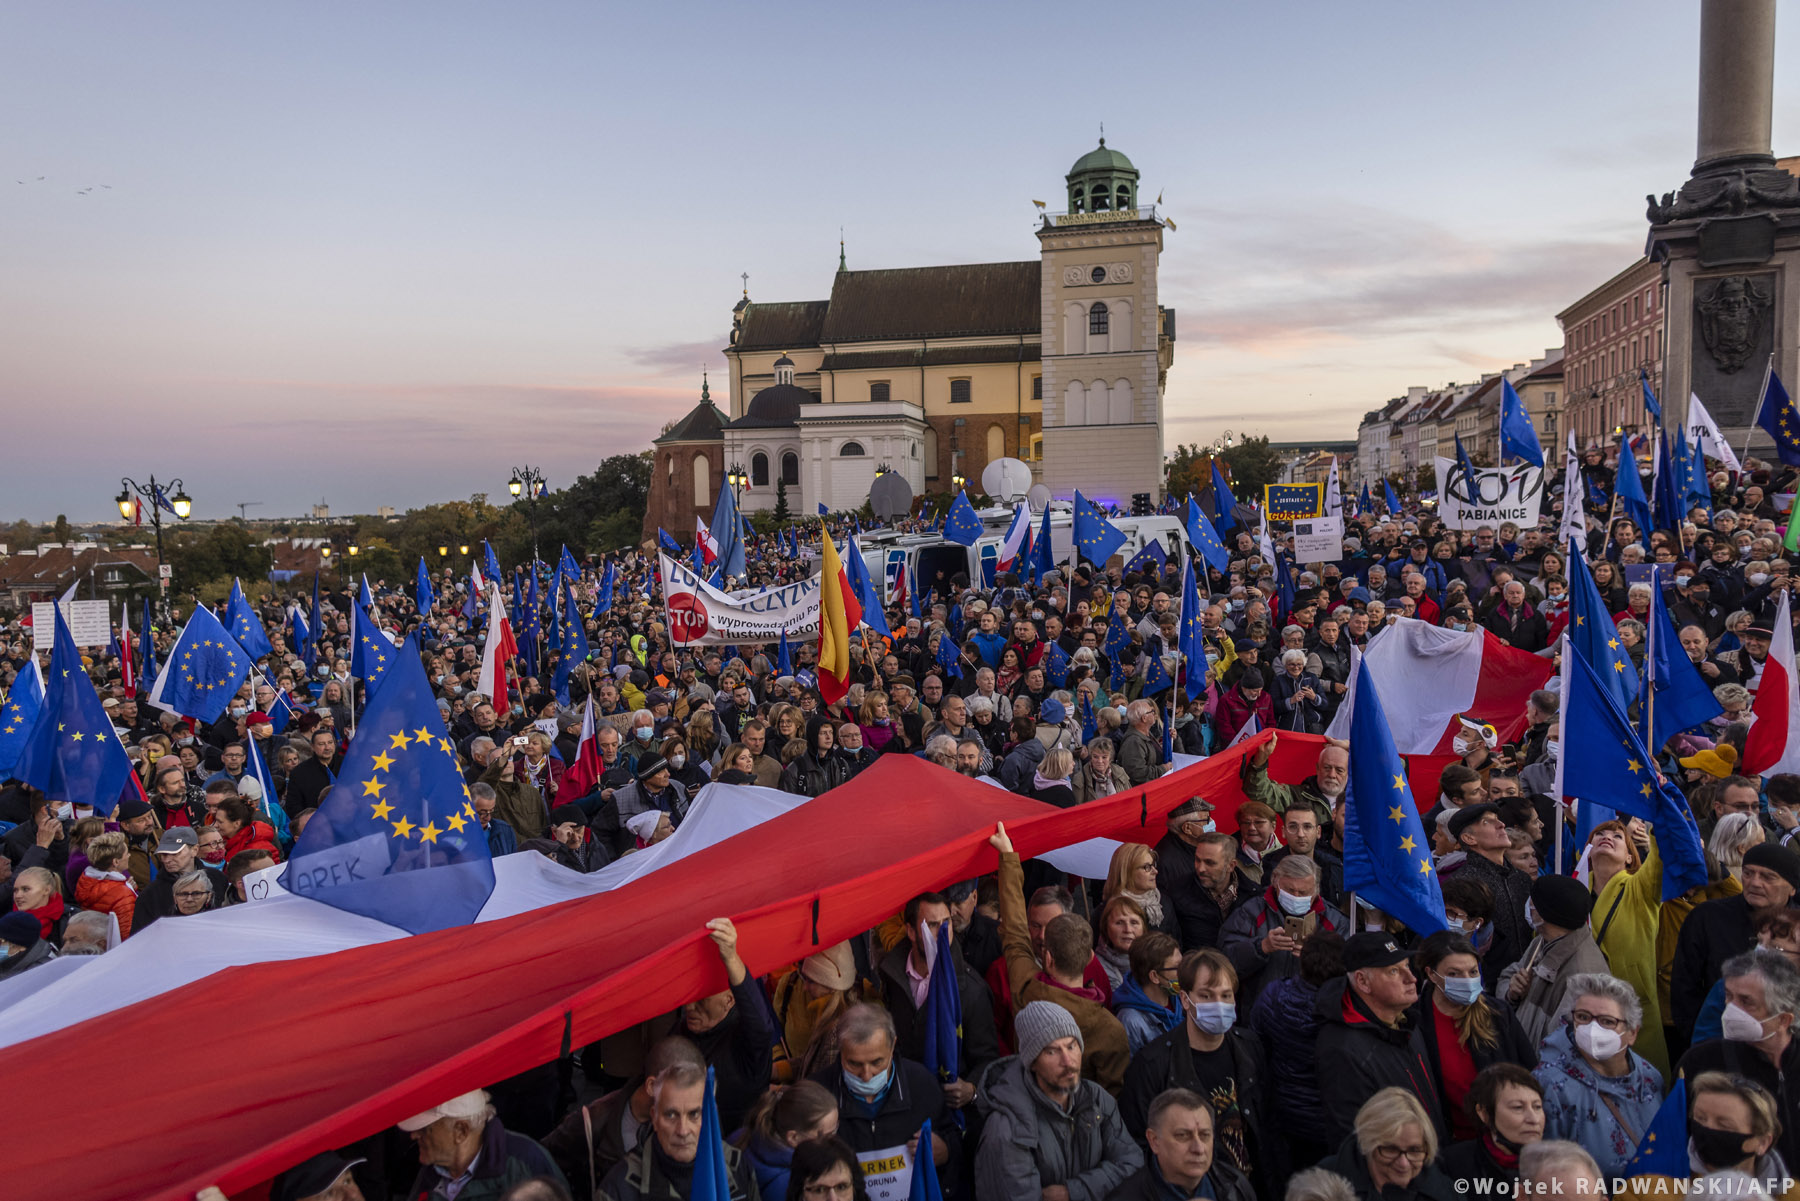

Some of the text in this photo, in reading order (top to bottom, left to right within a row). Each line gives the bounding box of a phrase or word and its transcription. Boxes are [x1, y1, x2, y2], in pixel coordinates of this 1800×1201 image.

[1058, 211, 1137, 222] TARAS WIDOKOWY
[1457, 508, 1527, 520] PABIANICE
[807, 604, 819, 616] Po
[669, 608, 705, 628] STOP
[866, 1176, 898, 1187] ORUNIA
[879, 1190, 890, 1198] do
